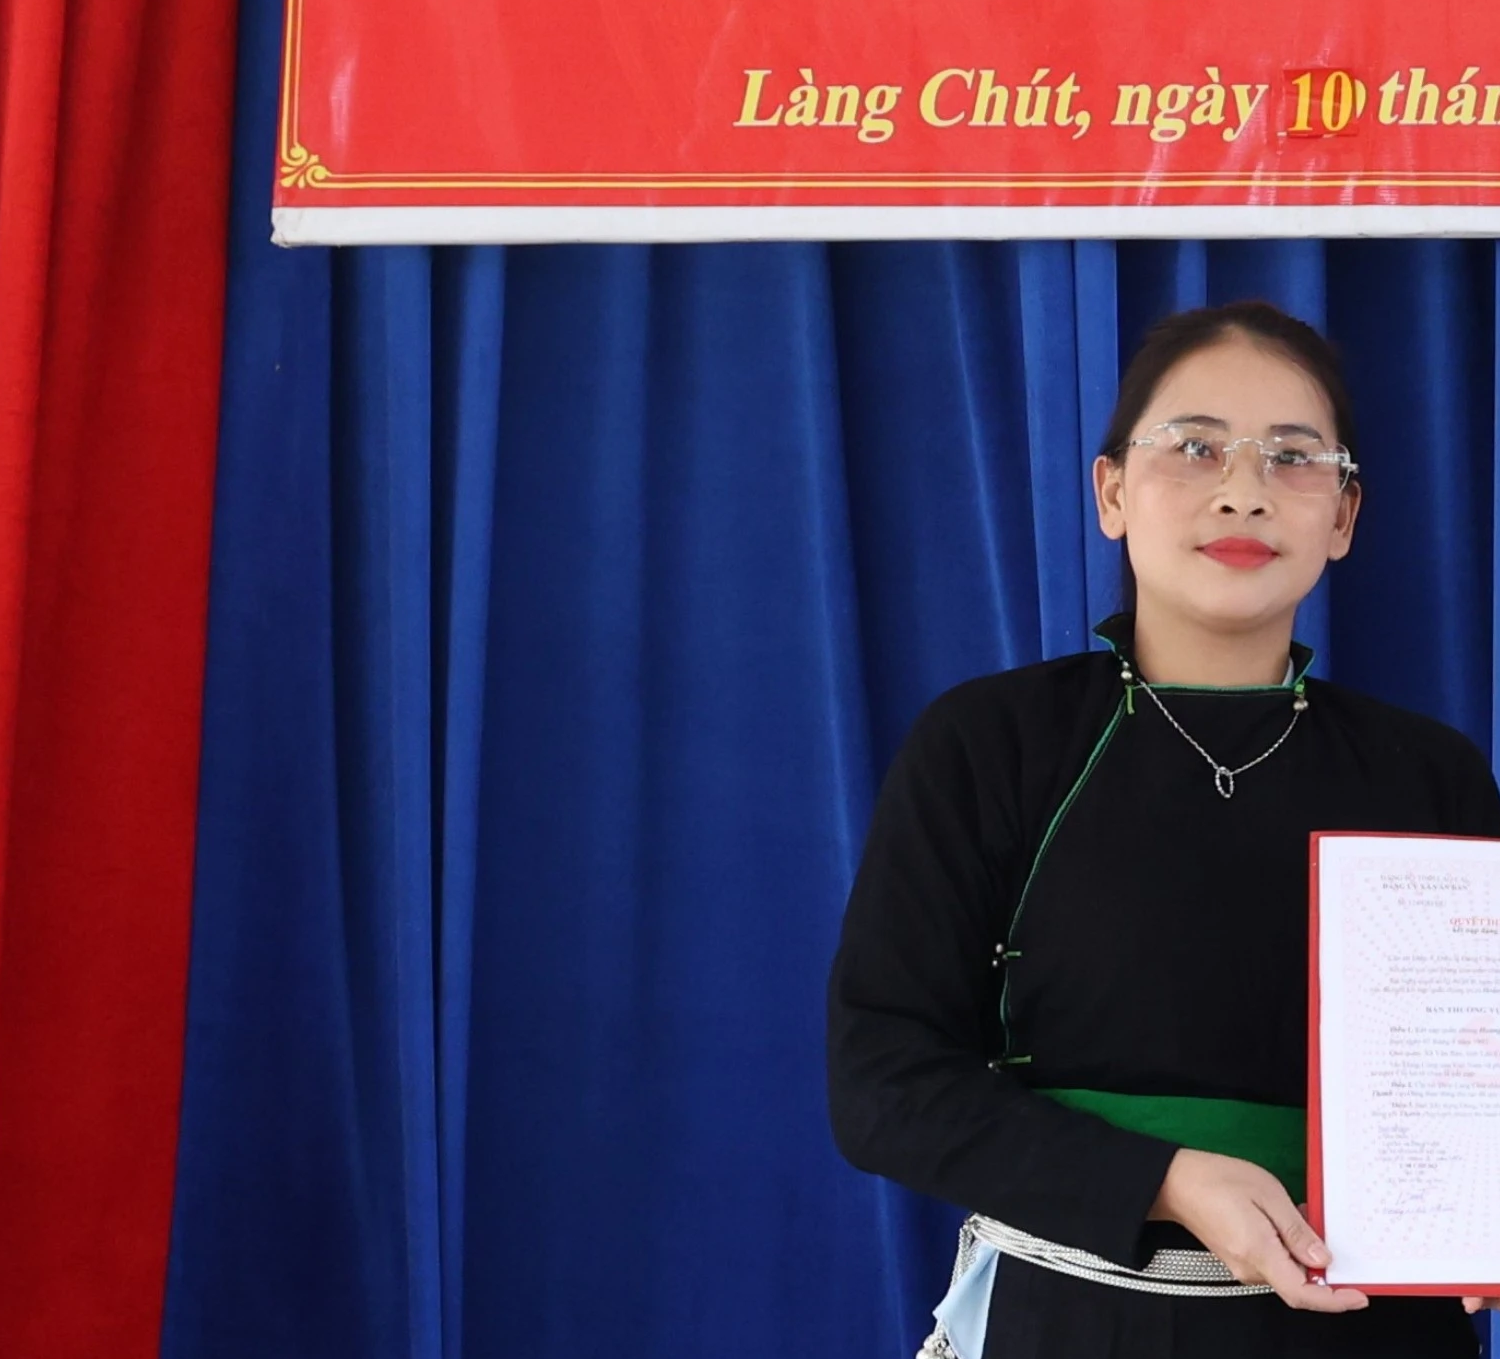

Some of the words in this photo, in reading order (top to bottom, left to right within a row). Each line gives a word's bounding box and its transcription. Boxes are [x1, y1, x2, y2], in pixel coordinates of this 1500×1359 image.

[732, 67, 903, 144] Làng
[919, 67, 1091, 140] Chút,
[1110, 66, 1270, 153] ngày
[1288, 71, 1353, 132] 10
